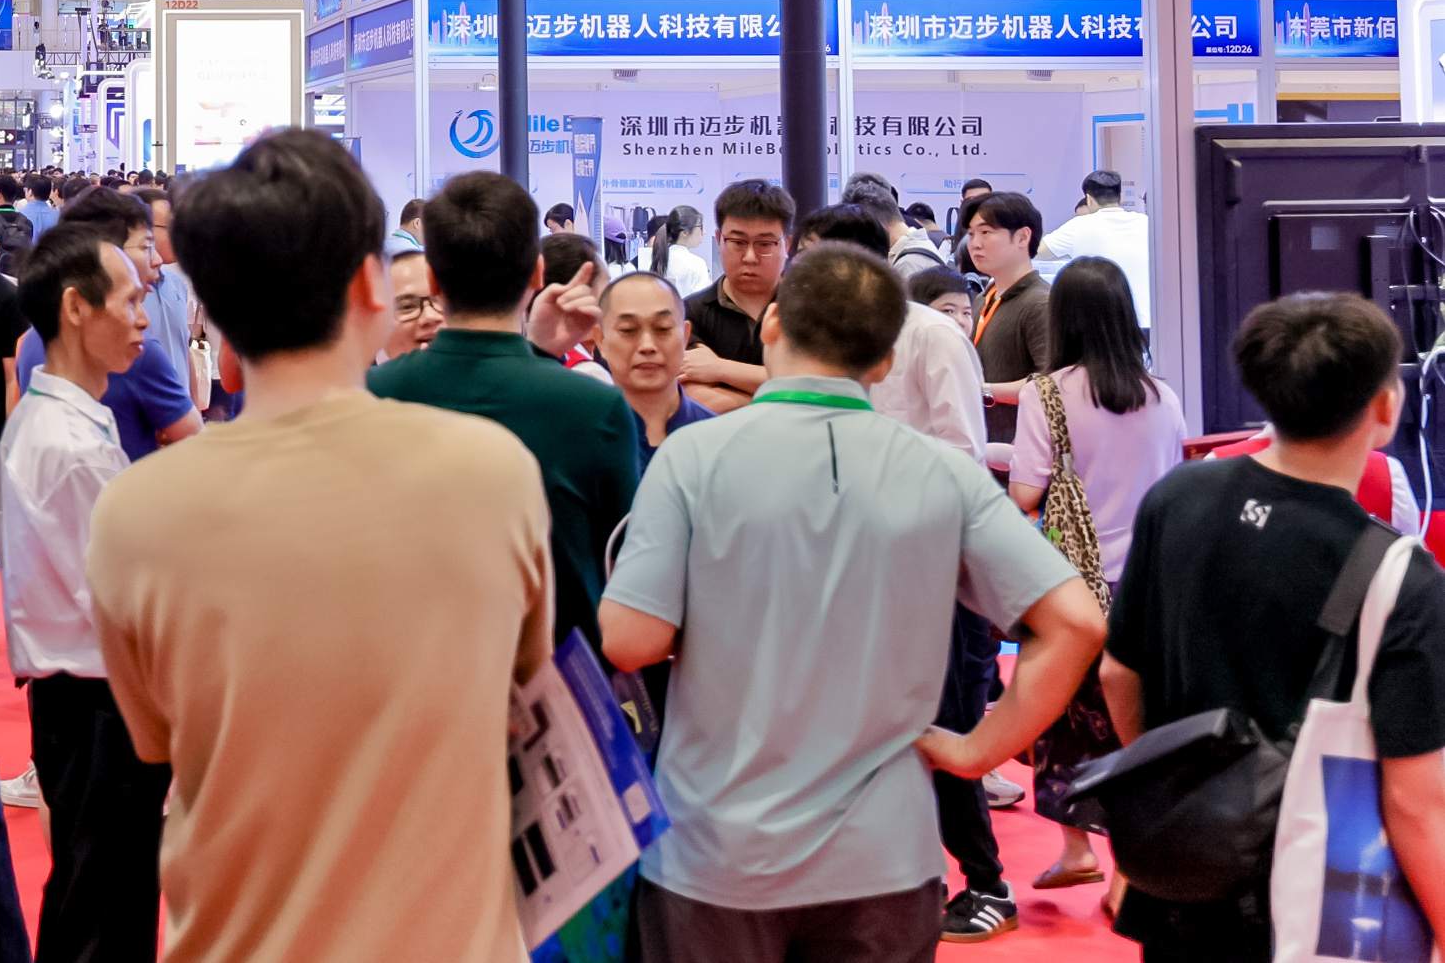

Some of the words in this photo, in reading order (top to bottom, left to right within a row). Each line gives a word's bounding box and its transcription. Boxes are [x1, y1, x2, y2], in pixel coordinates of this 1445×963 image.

[166, 1, 199, 10] 12D22
[447, 14, 780, 39] 深圳迈步机器人科技有限公
[869, 14, 1238, 40] 深圳市迈步机器人科技公司
[1288, 16, 1396, 39] 东莞市新佰
[1205, 44, 1253, 54] 展位号:12D26
[528, 115, 560, 132] ile
[622, 142, 714, 156] Shenzhen
[723, 142, 786, 156] MileB
[903, 143, 939, 158] Co.,
[951, 143, 988, 156] Ltd.
